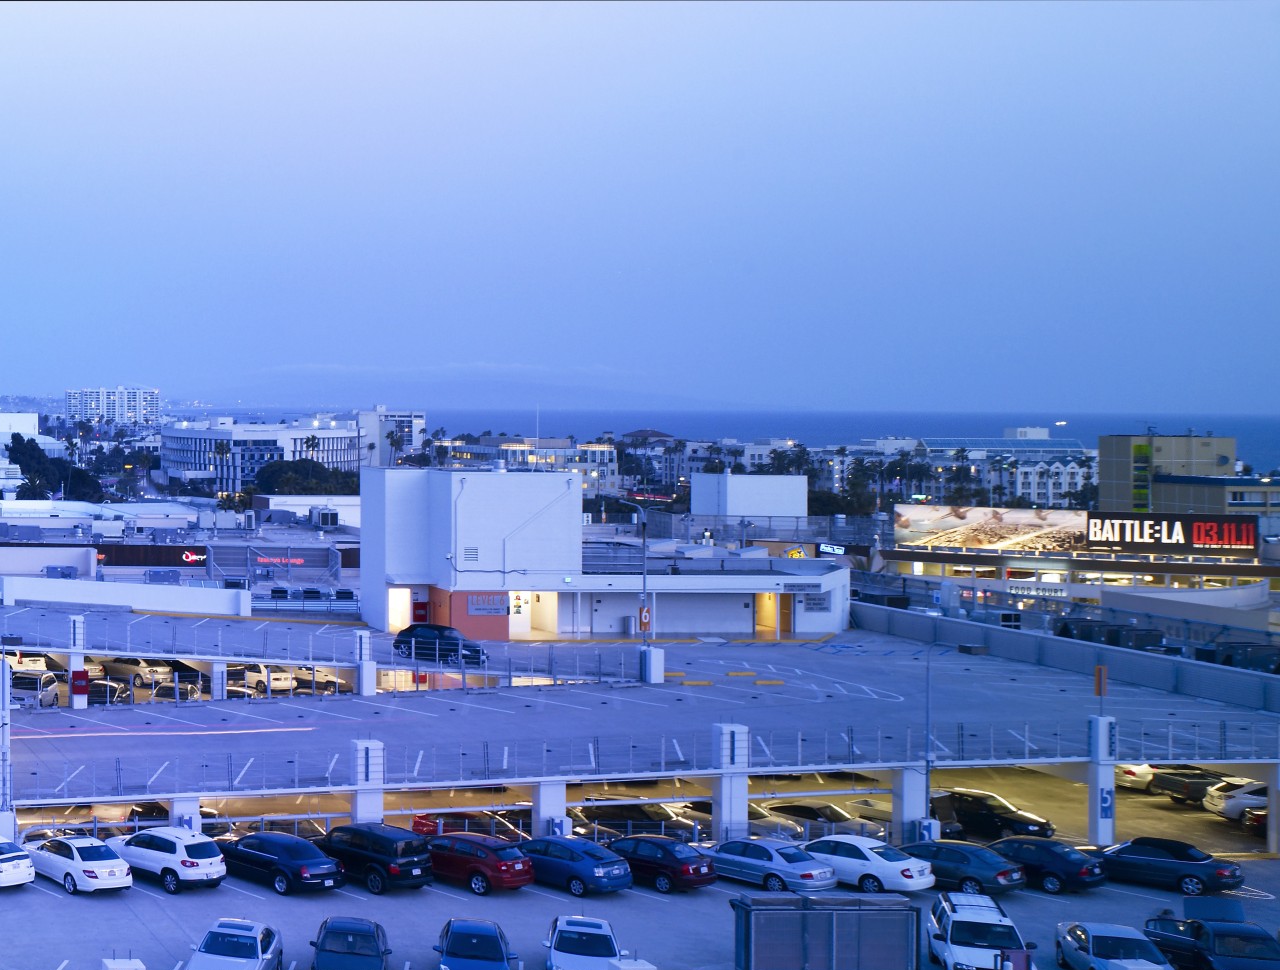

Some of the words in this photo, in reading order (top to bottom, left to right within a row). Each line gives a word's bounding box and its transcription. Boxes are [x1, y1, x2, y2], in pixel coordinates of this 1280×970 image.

[1089, 518, 1185, 544] BATTLE:LA
[1192, 522, 1254, 544] 03.11.11
[1009, 586, 1032, 595] FOOD
[1036, 587, 1064, 596] COURT
[471, 595, 498, 605] LEVEL
[500, 595, 505, 605] 6
[642, 607, 650, 622] 6
[1101, 788, 1112, 807] 5
